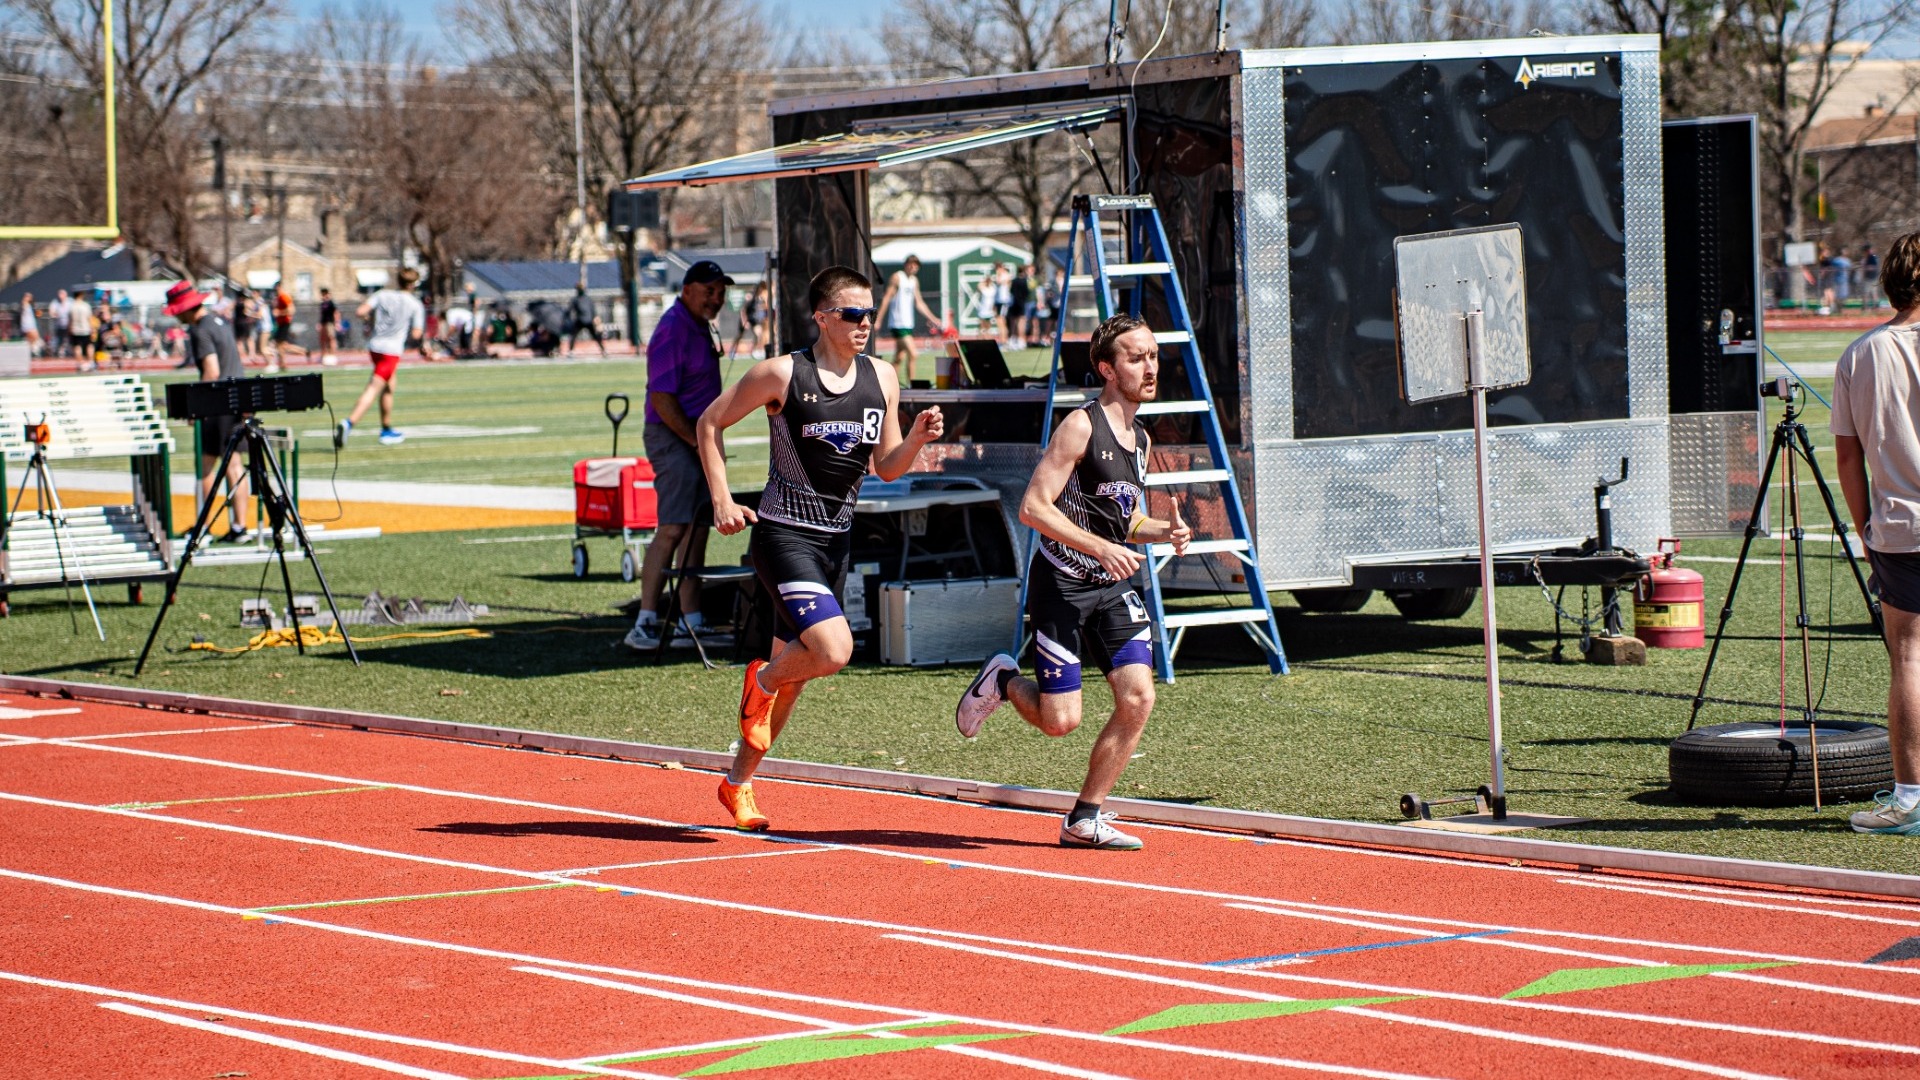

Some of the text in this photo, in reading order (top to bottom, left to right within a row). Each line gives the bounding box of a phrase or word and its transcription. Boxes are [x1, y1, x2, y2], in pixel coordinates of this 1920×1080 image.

[1514, 57, 1596, 84] ARISING
[1106, 198, 1152, 206] LOUISVILLE
[803, 421, 863, 437] McKENDR
[865, 411, 880, 441] 3
[1391, 571, 1426, 584] VIPER
[1130, 593, 1146, 620] 9
